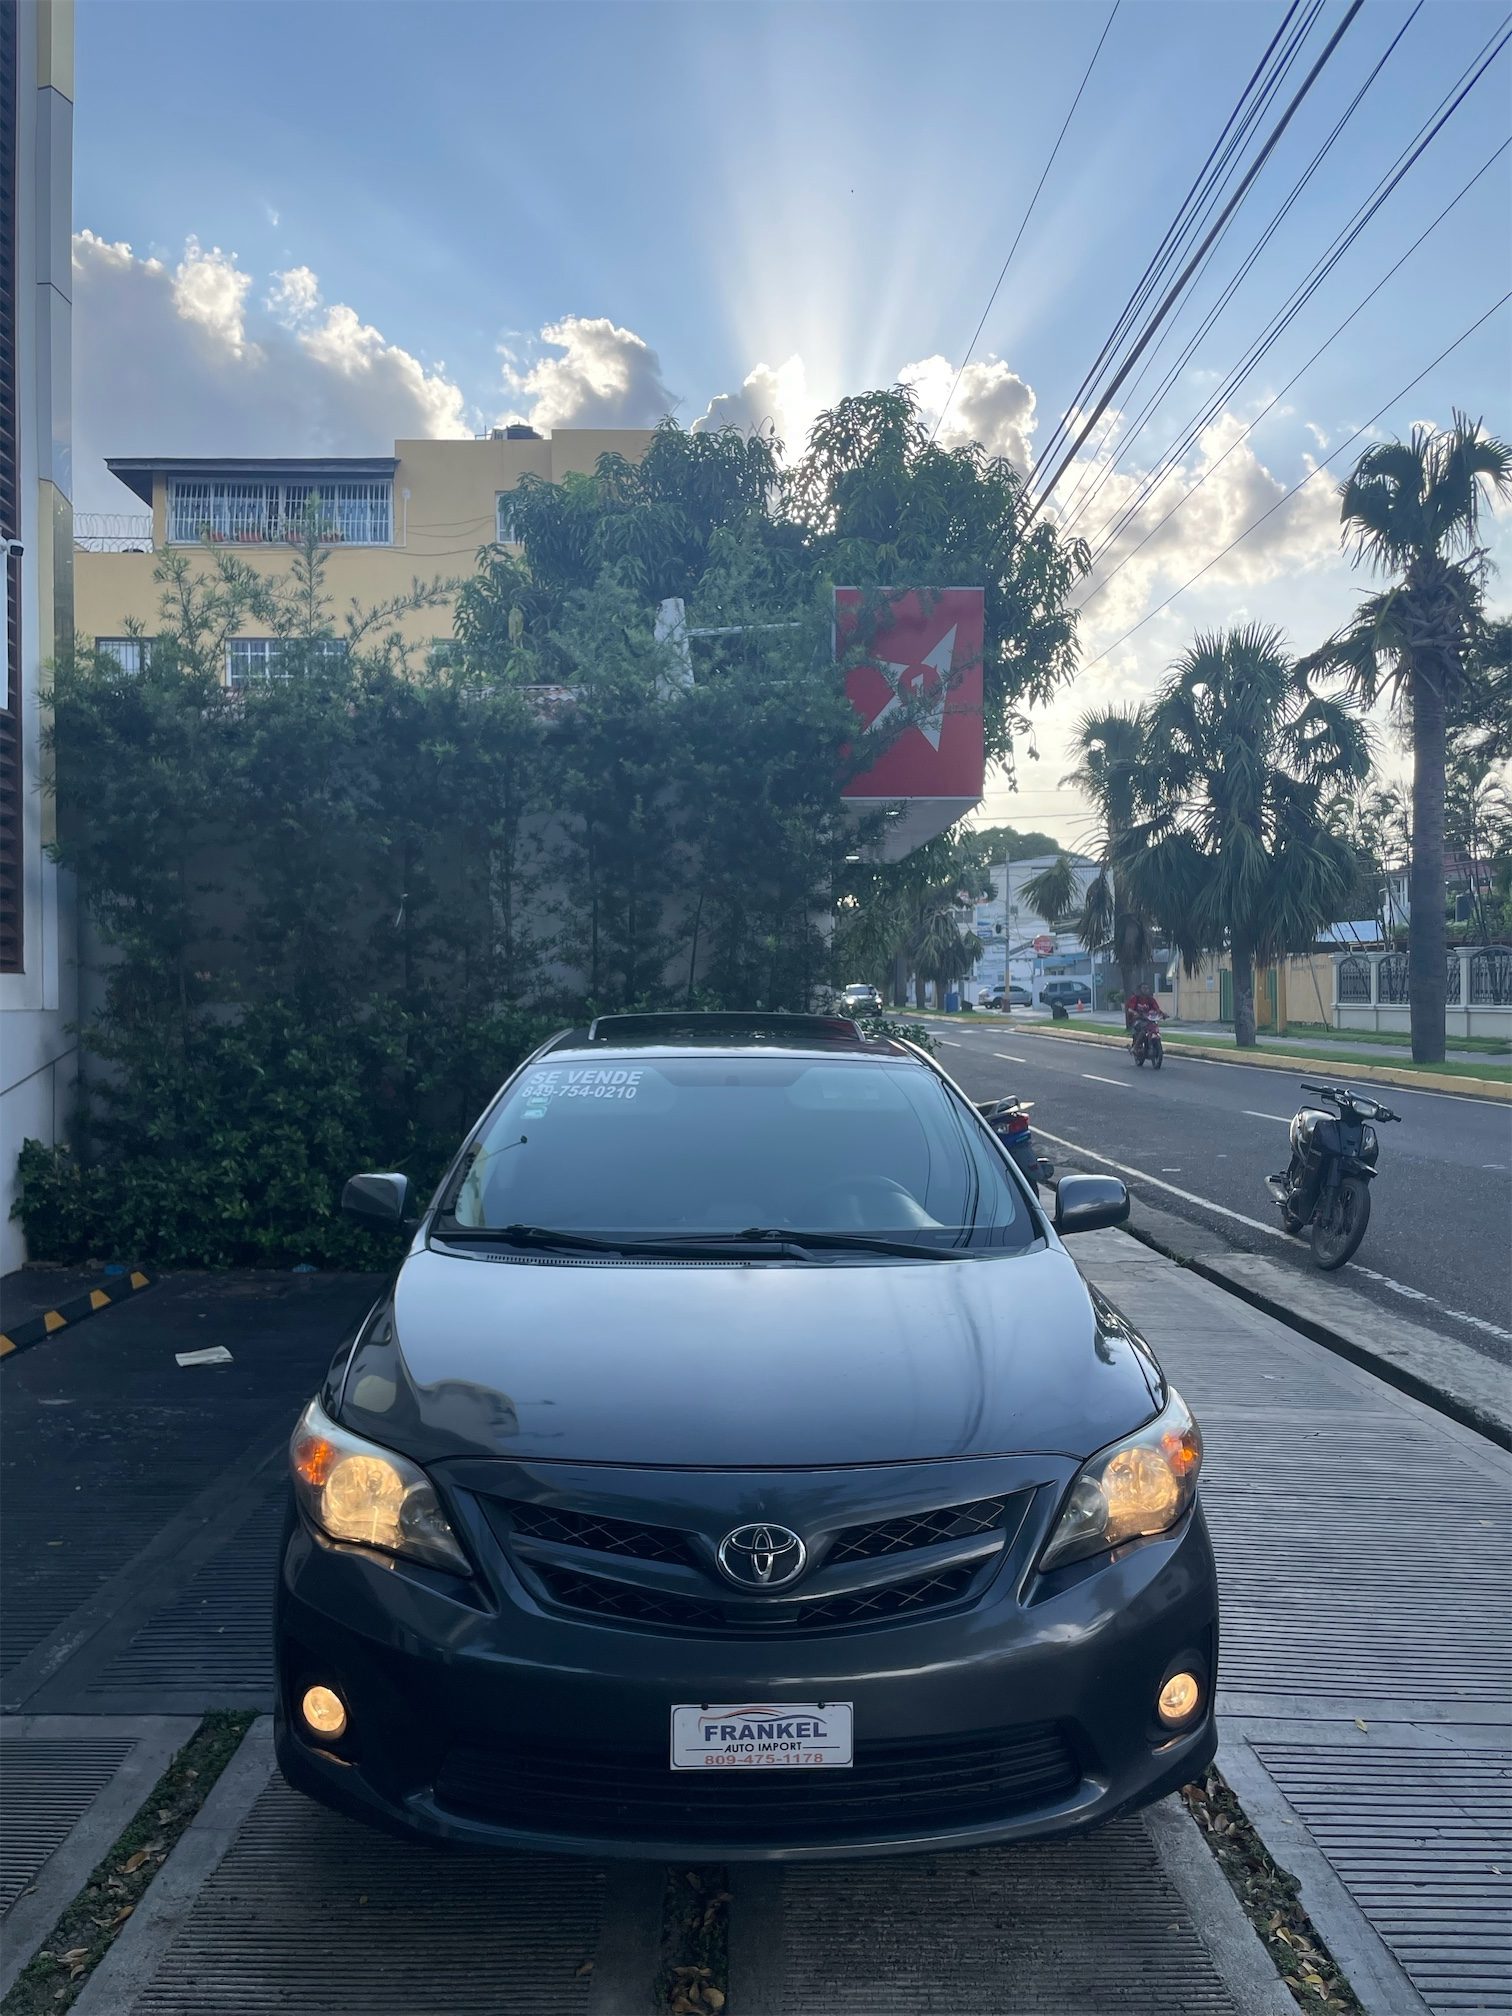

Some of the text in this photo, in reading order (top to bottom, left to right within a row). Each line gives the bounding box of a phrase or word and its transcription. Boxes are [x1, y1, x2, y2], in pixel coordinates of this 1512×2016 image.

[530, 1071, 644, 1085] SE VENDE
[522, 1085, 638, 1099] 849-754-0210
[704, 1722, 828, 1742] FRANKEL
[724, 1742, 803, 1753] AUTO IMPORT
[704, 1753, 824, 1766] 809-475-1178
